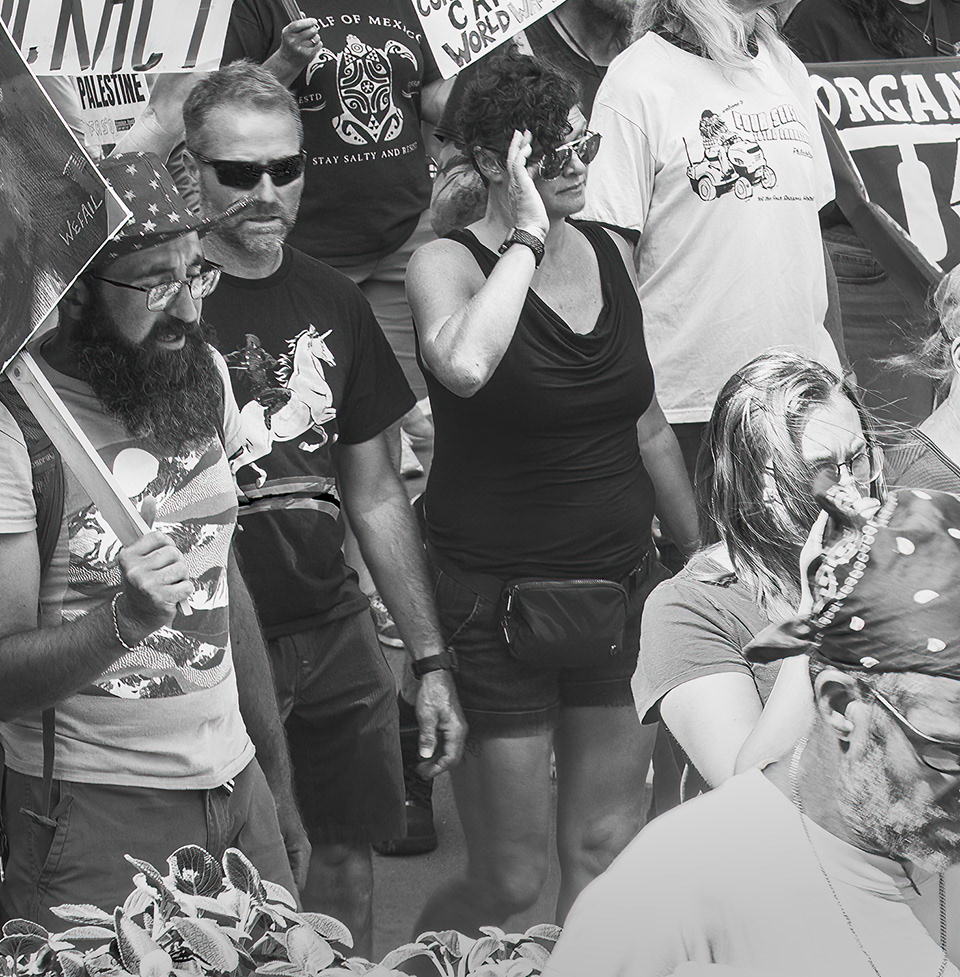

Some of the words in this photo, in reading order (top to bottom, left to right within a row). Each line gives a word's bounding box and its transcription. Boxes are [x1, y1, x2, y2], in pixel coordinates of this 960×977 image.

[340, 14, 361, 25] OF
[441, 9, 510, 68] WORLD
[76, 73, 146, 110] PALESTINE
[311, 153, 340, 166] STAY
[343, 149, 377, 165] SALTY
[380, 146, 401, 160] AND
[58, 194, 104, 247] WEFAIL
